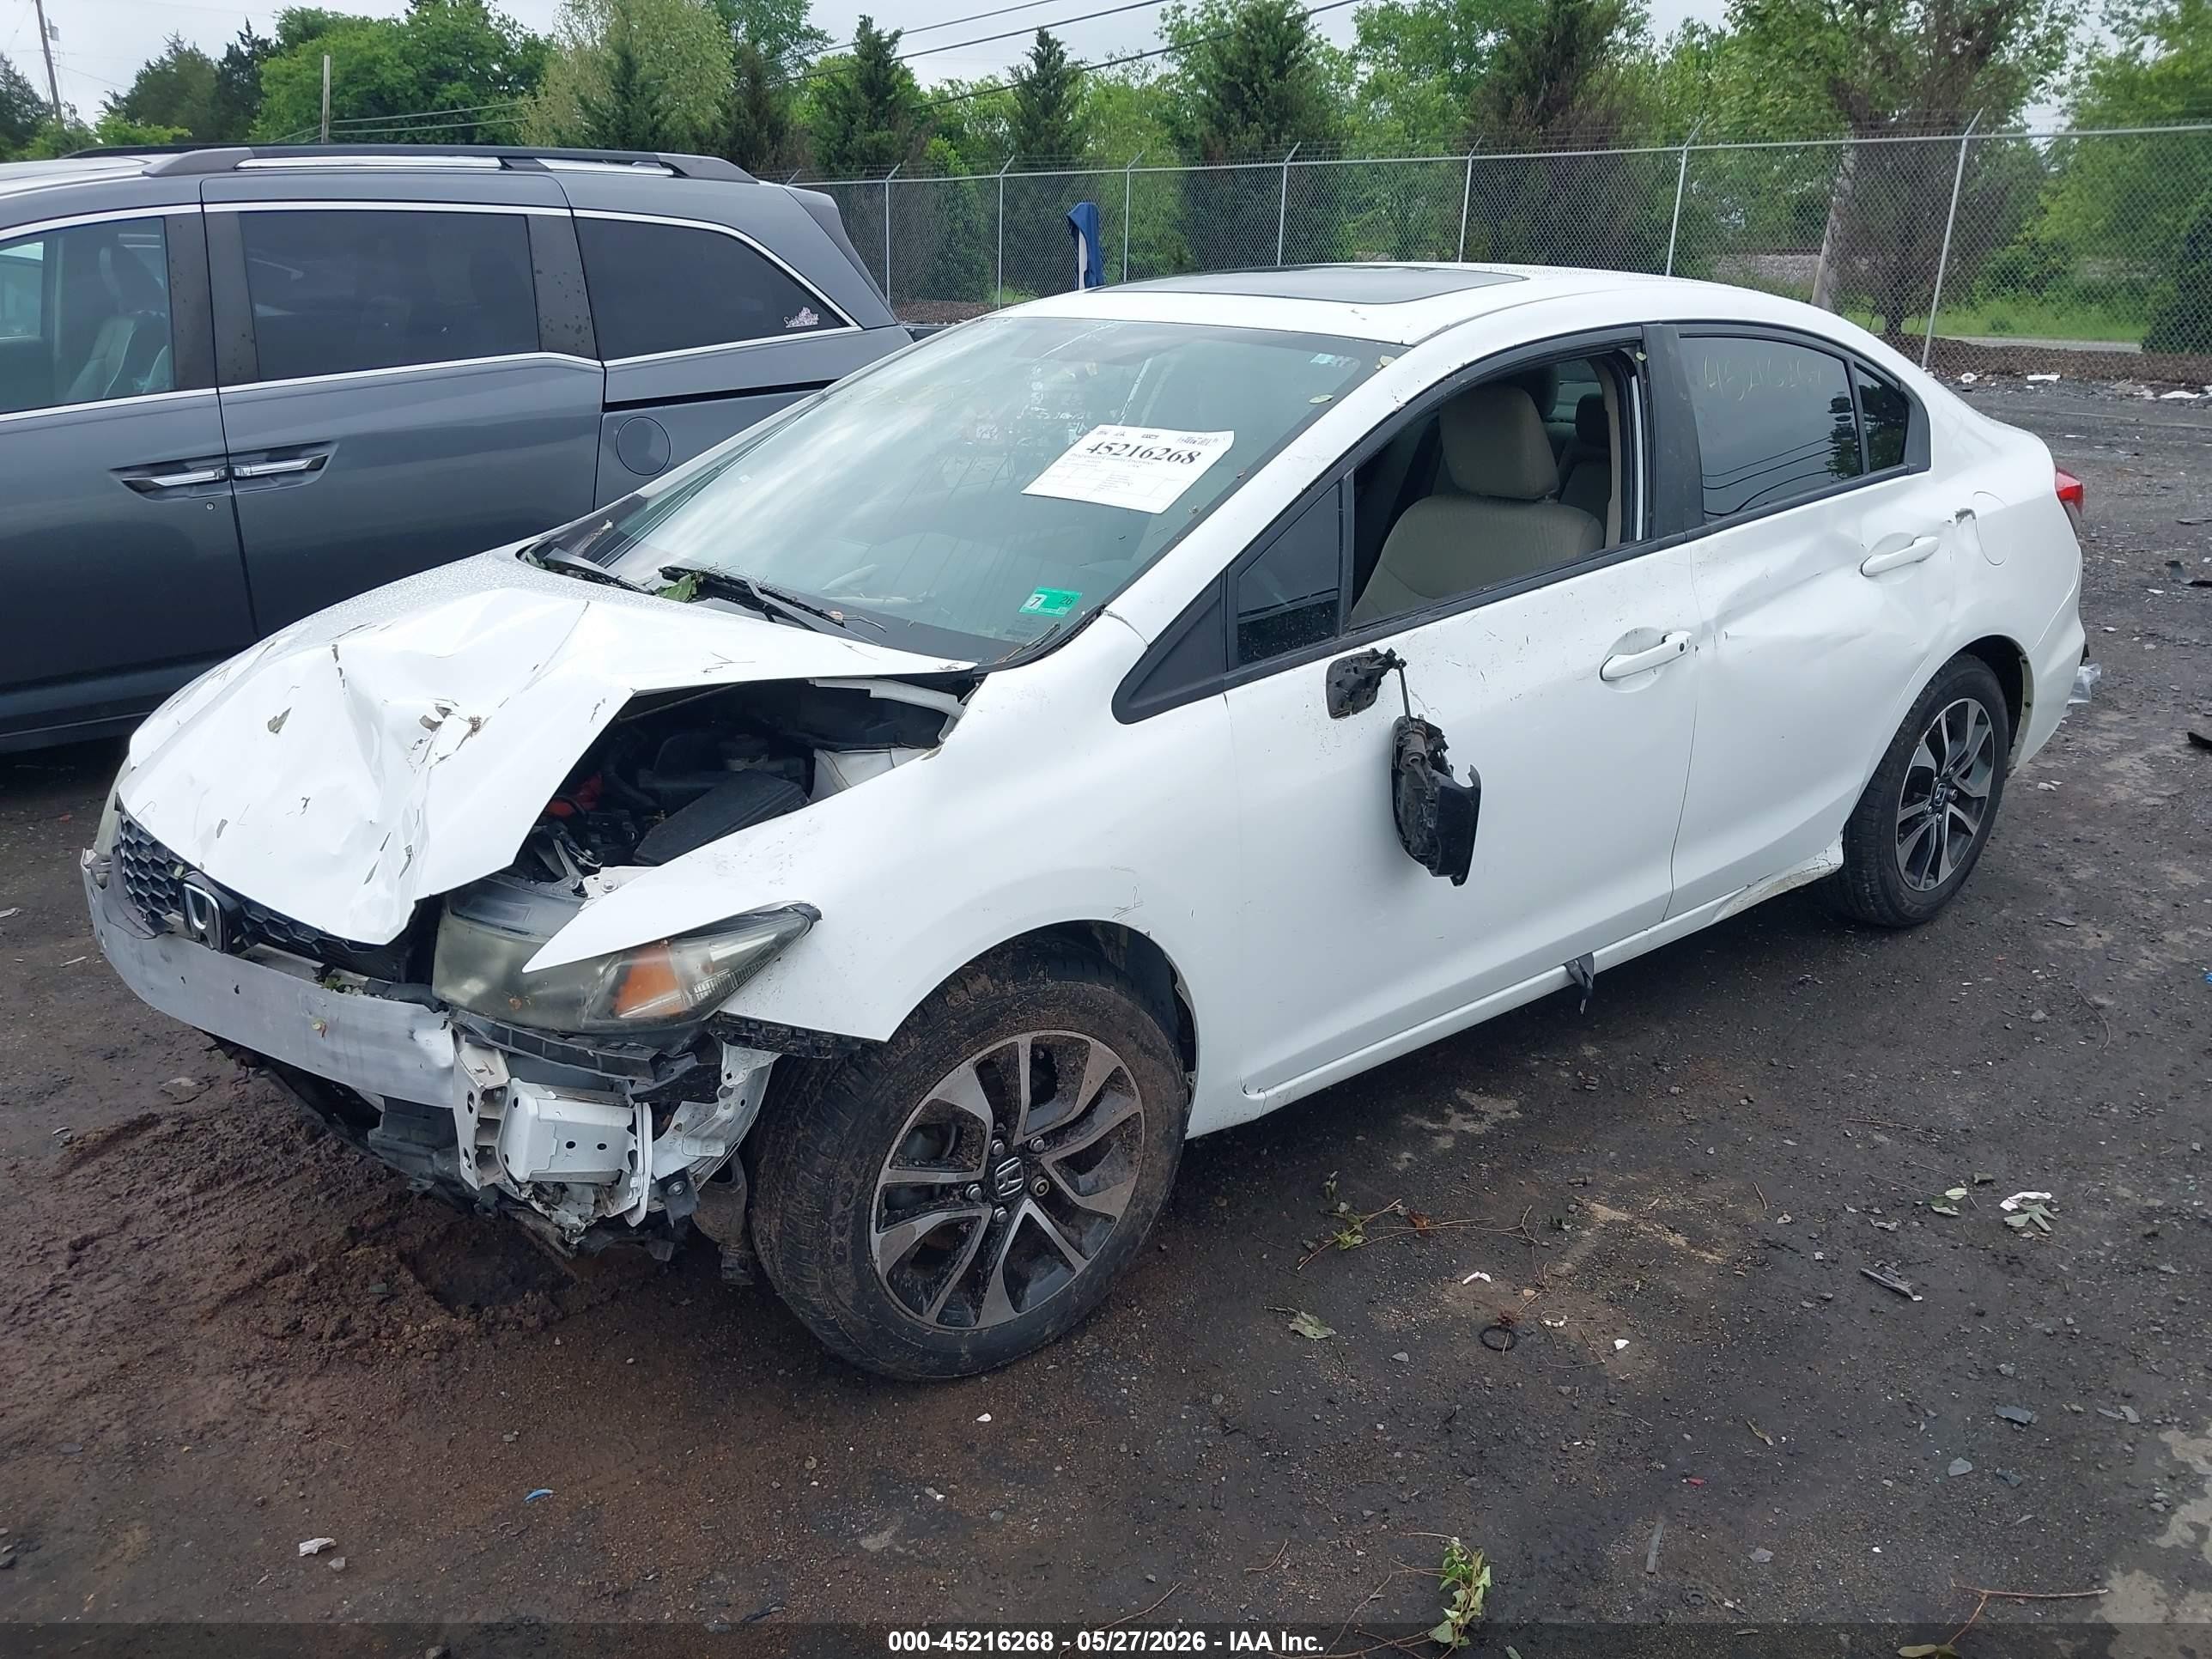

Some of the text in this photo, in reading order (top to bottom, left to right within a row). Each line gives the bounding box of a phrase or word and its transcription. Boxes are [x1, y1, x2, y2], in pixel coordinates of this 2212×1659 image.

[1085, 441, 1202, 465] 45216268
[1029, 595, 1075, 607] 7 26
